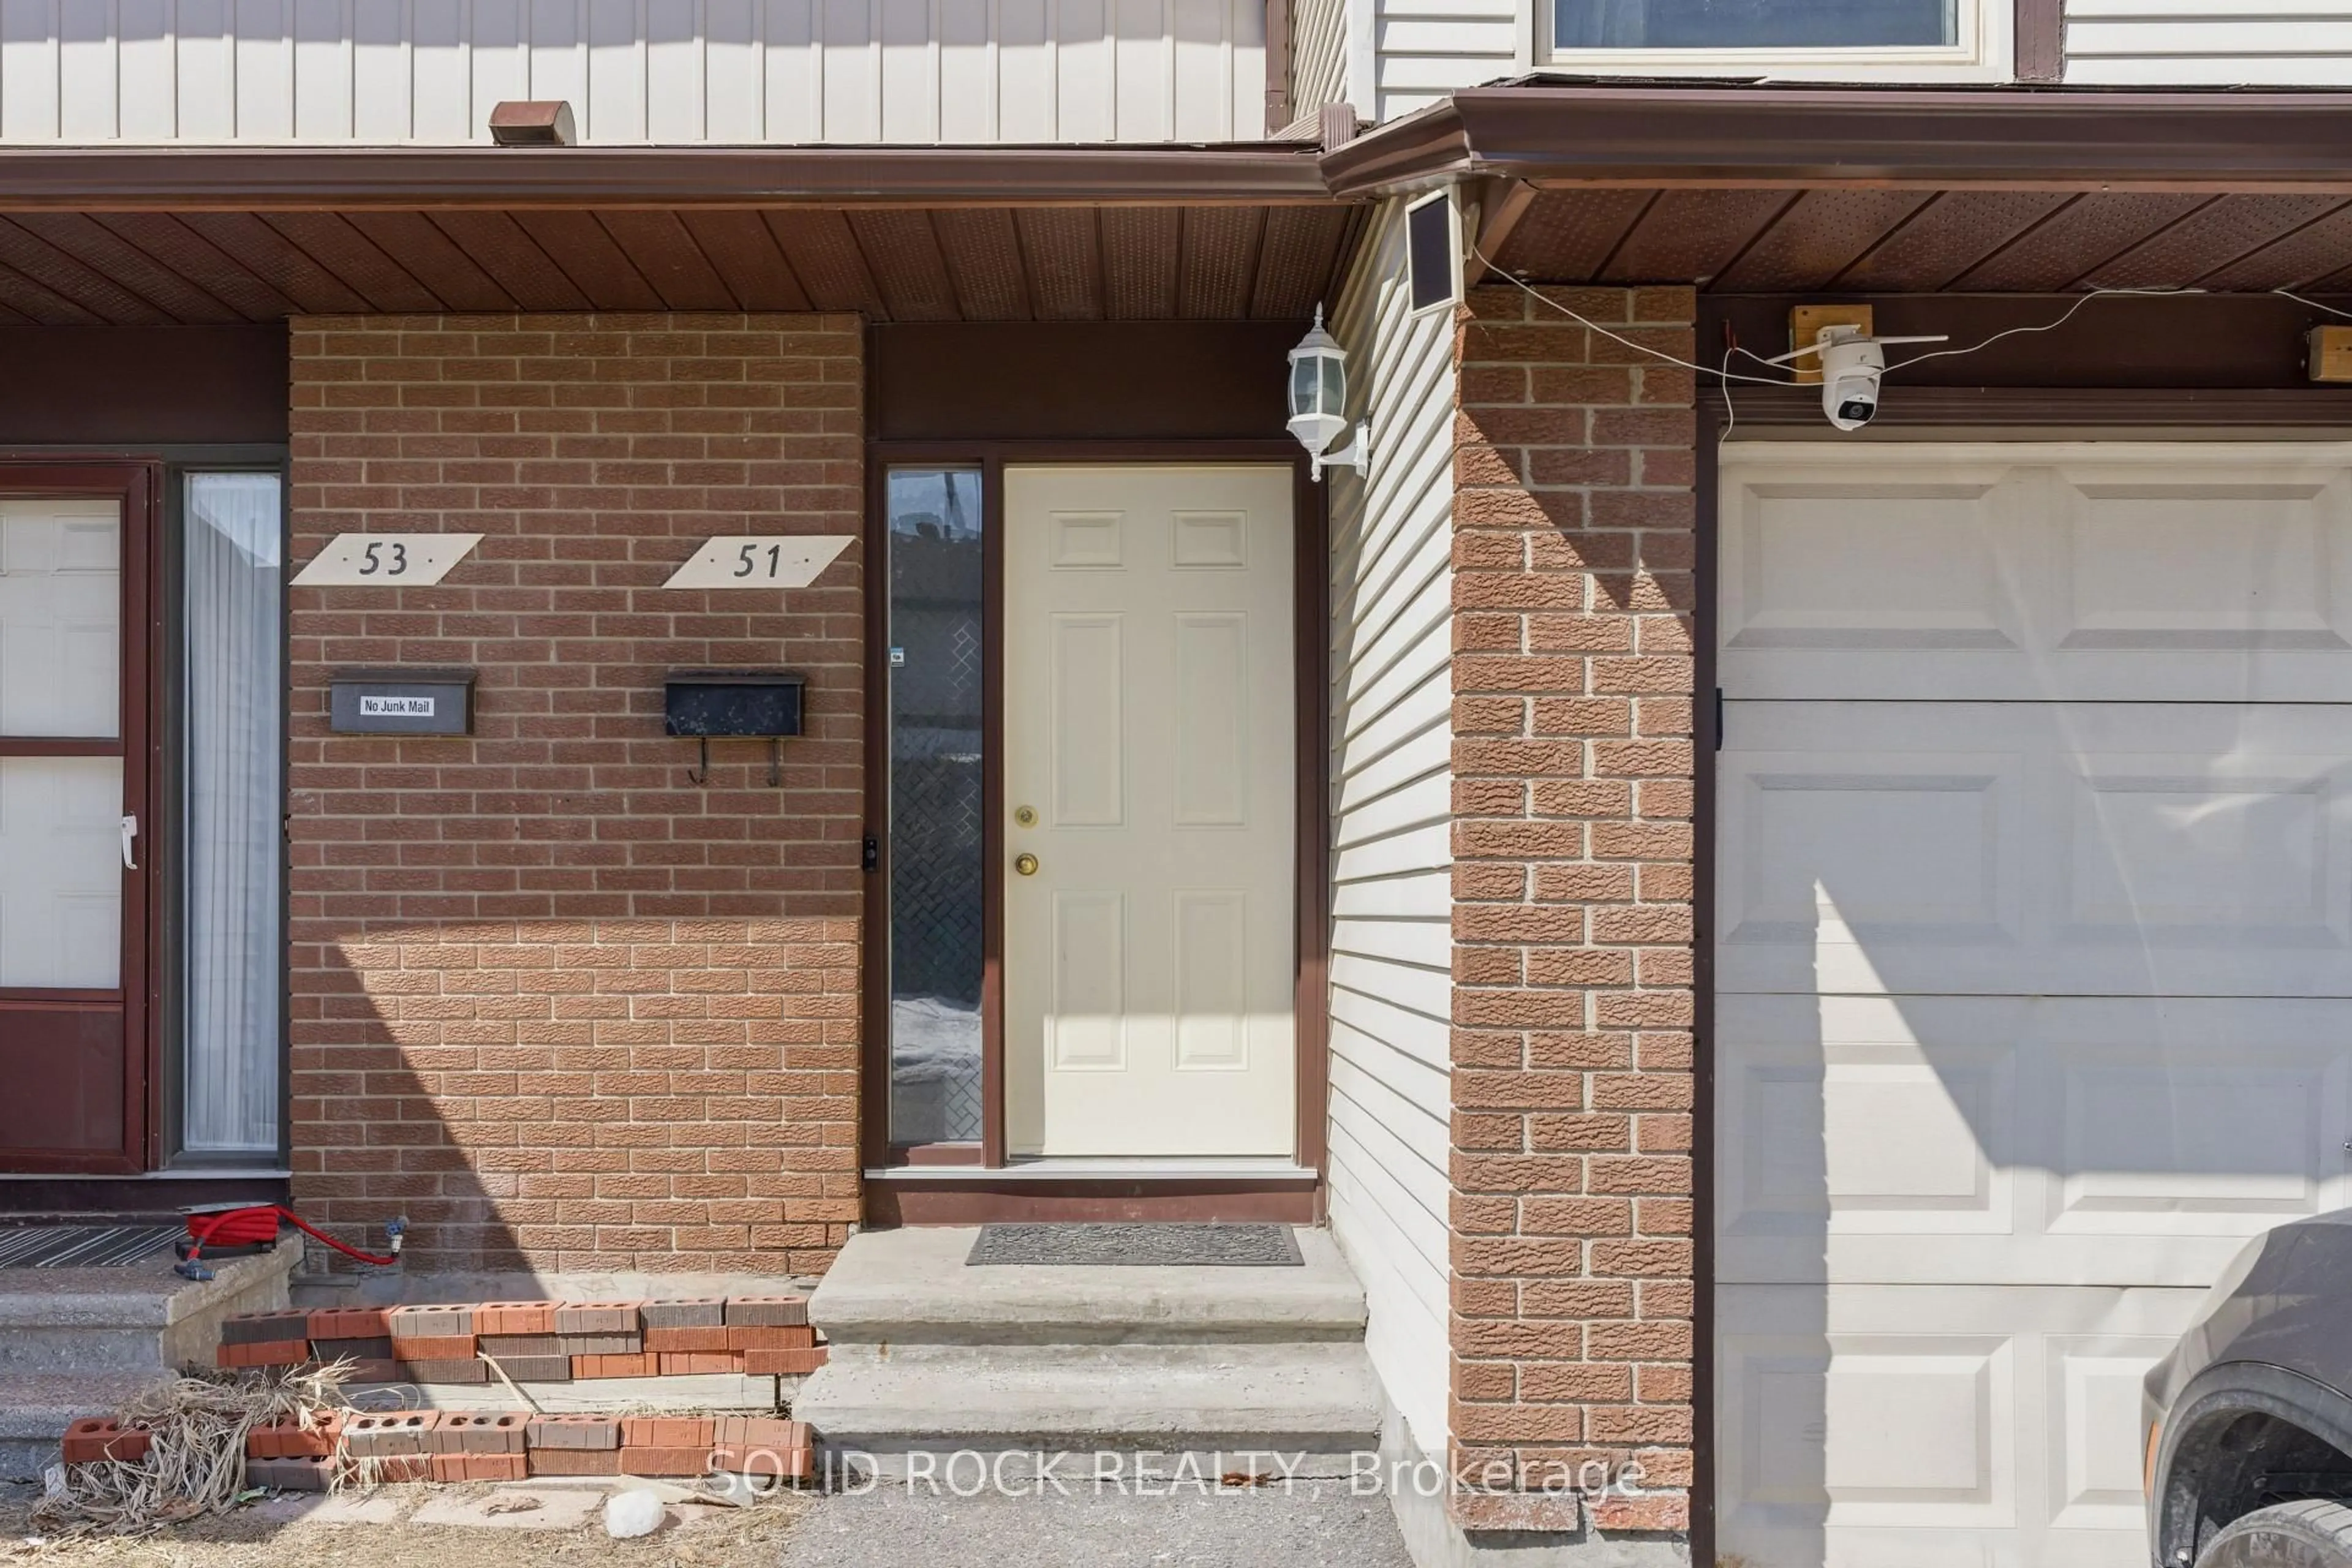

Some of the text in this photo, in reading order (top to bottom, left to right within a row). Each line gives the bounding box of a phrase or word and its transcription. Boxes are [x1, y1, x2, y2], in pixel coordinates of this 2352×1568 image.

[359, 541, 407, 575] 53
[733, 543, 780, 578] 51
[365, 700, 429, 712] No Junk Mail
